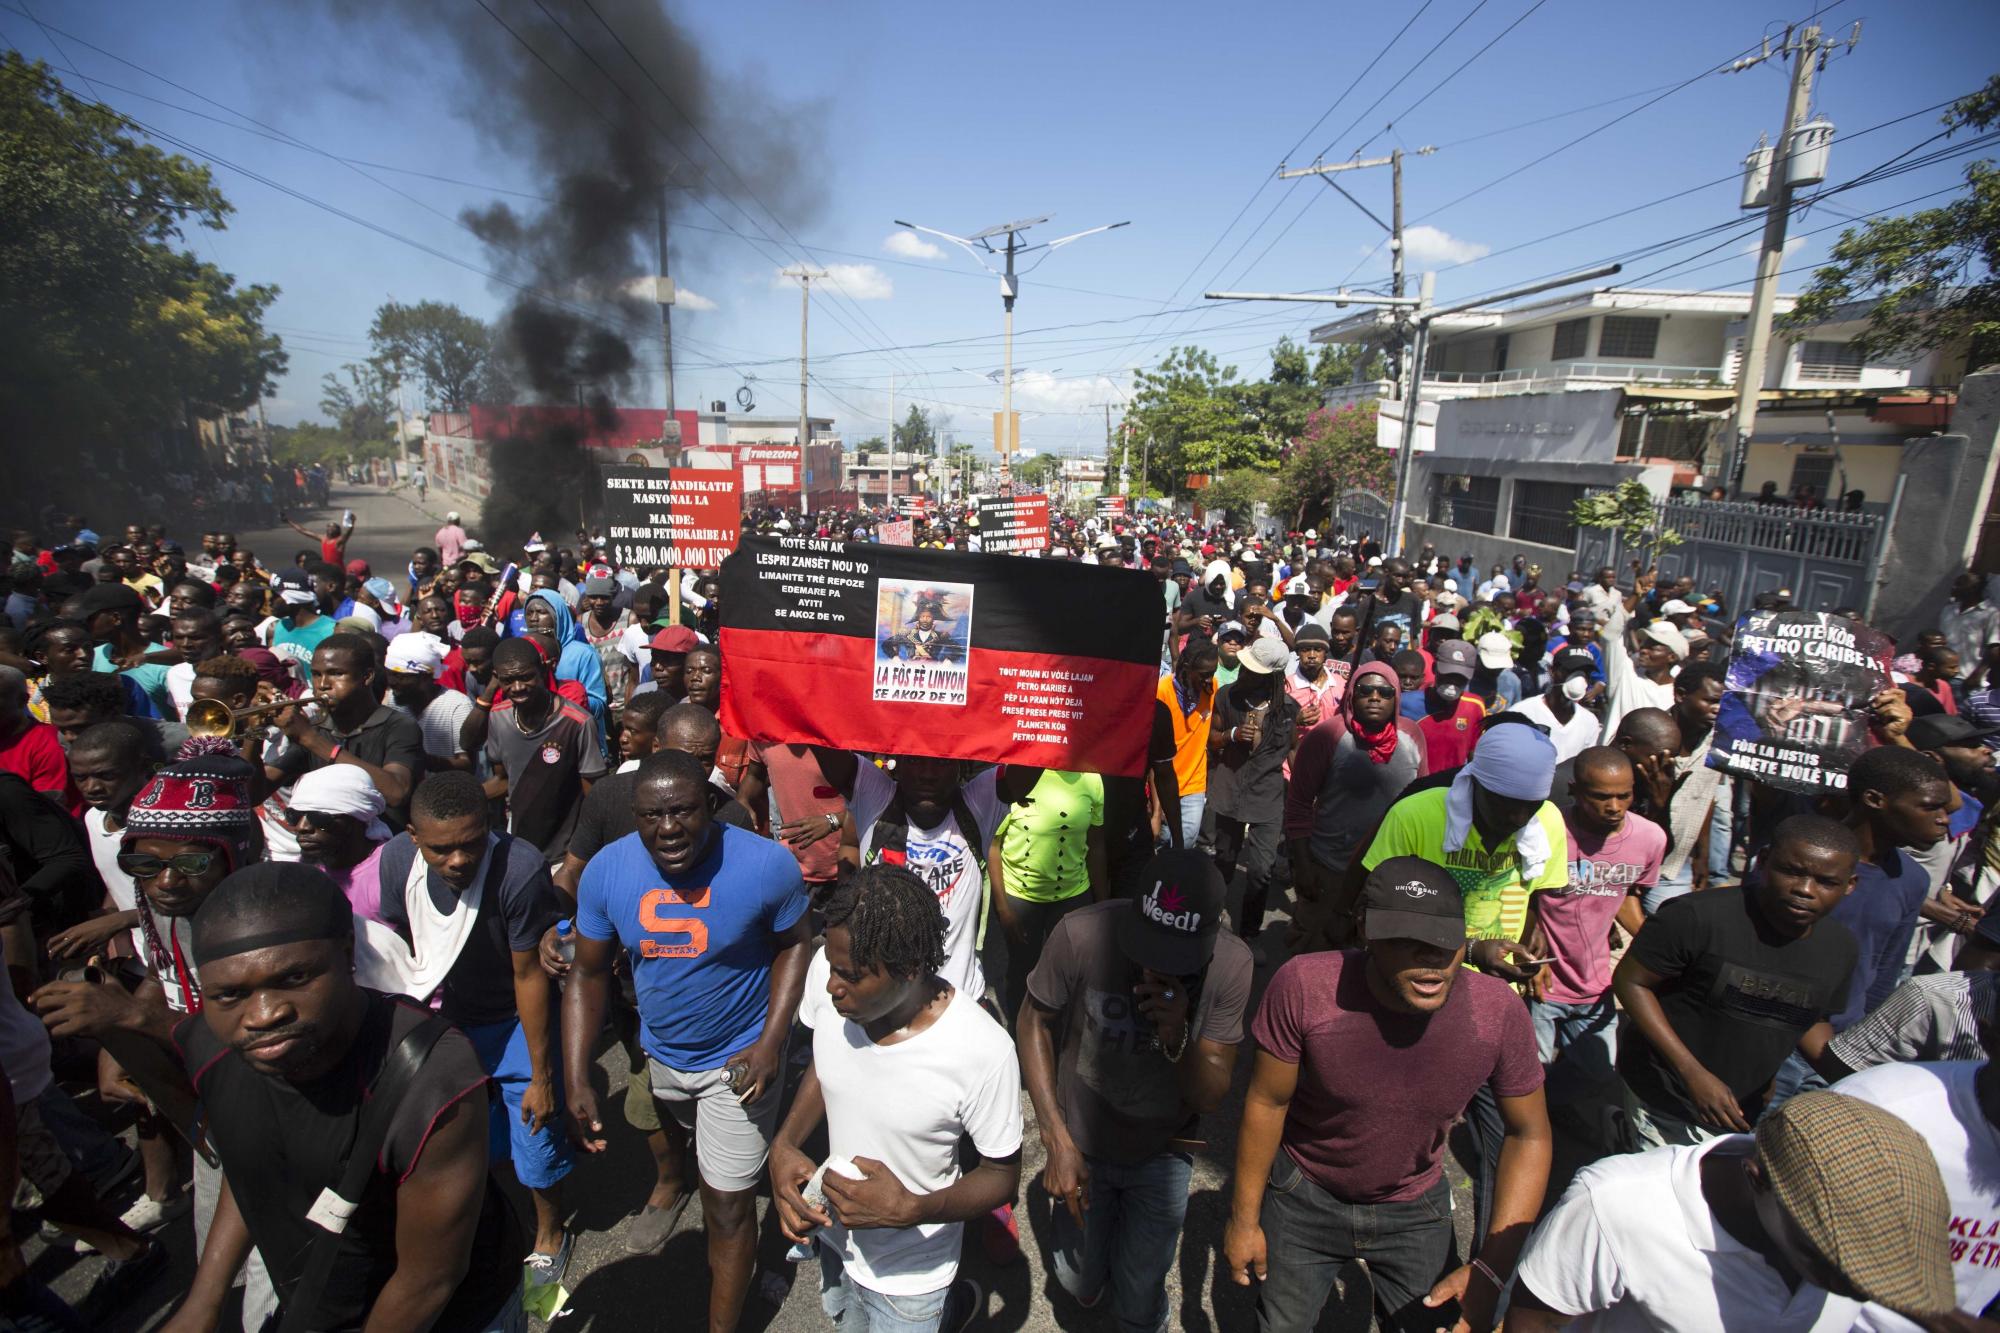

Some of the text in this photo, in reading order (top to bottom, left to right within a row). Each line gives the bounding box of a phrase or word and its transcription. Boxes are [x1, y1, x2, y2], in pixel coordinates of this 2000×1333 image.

[607, 478, 733, 492] SEKTE REVANDIKATIF
[633, 493, 709, 505] NASYONAL LA
[649, 514, 695, 525] MANDE:
[610, 527, 630, 538] KOT
[631, 527, 652, 539] KOB
[720, 529, 730, 541] A
[780, 537, 845, 553] KOTE SAN AK
[615, 543, 622, 565] $
[624, 545, 706, 566] 3.800.000.000
[756, 553, 790, 566] LESPRI
[832, 560, 853, 572] NOU
[855, 562, 869, 574] YO
[759, 571, 804, 582] LIMANITE
[827, 576, 865, 589] REPOZE
[781, 585, 841, 598] EDEMARE PA
[798, 599, 822, 608] AYITI
[775, 609, 845, 622] SE AKOZ DE YO
[1777, 623, 1825, 640] KOTE
[1741, 634, 1801, 655] PETRO
[1803, 641, 1865, 667] CARIBE
[876, 666, 889, 686] LA
[927, 669, 966, 691] LINYON
[999, 667, 1018, 677] TOUT
[1019, 669, 1040, 679] MOUN
[1041, 670, 1049, 679] KI
[1070, 672, 1094, 682] LAJAN
[875, 688, 965, 703] SE AKOZ DE YO
[1016, 682, 1073, 694] PETRO KARIBE A
[1019, 695, 1028, 703] LA
[1029, 696, 1049, 705] PRAN
[1002, 706, 1084, 720] PRESE PRESE PRESE VIT
[1012, 732, 1036, 742] PETRO
[1063, 736, 1068, 745] A
[1758, 745, 1775, 758] LA
[1776, 748, 1820, 766] JISTIS
[1728, 753, 1779, 775] ARETE
[928, 858, 964, 880] ARE
[1151, 880, 1163, 899] I
[1142, 894, 1201, 933] Weed!
